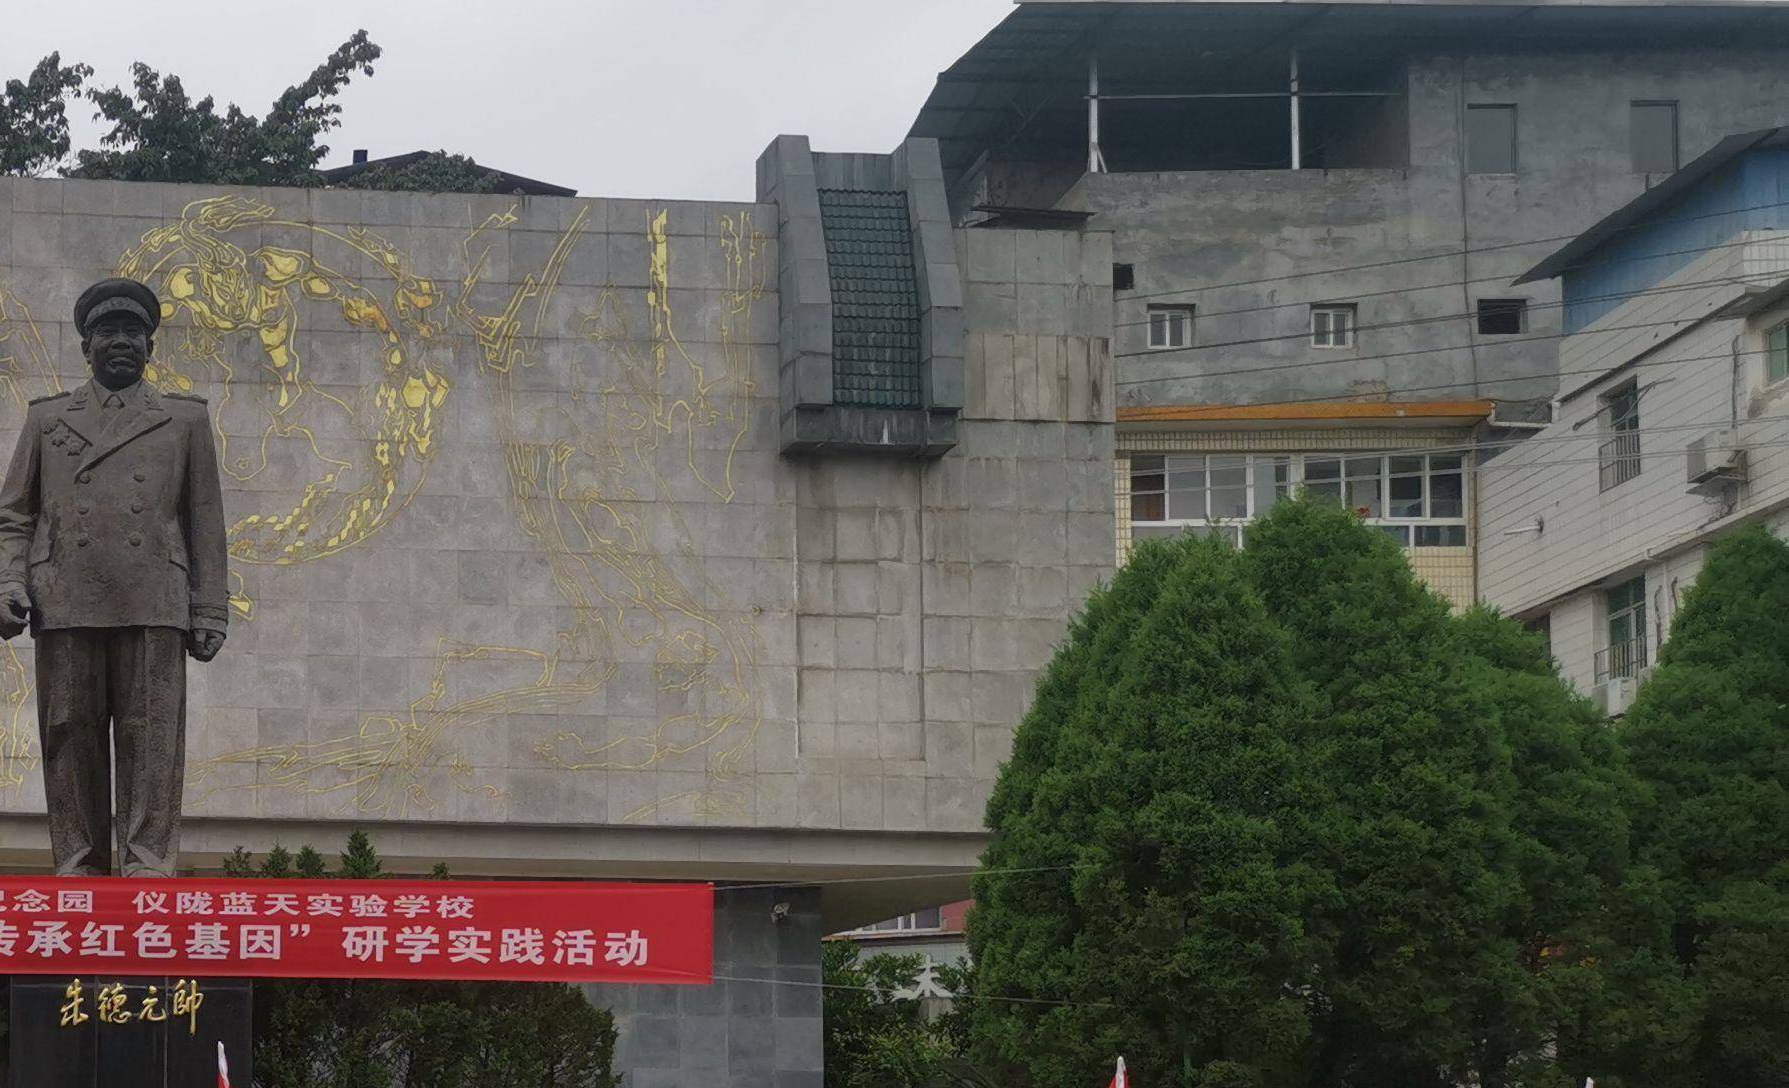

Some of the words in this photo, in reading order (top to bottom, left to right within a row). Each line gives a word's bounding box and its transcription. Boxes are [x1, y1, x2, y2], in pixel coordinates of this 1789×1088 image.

[132, 890, 475, 920] 仪陇蓝天实验学校
[342, 925, 649, 967] 研学实践活动
